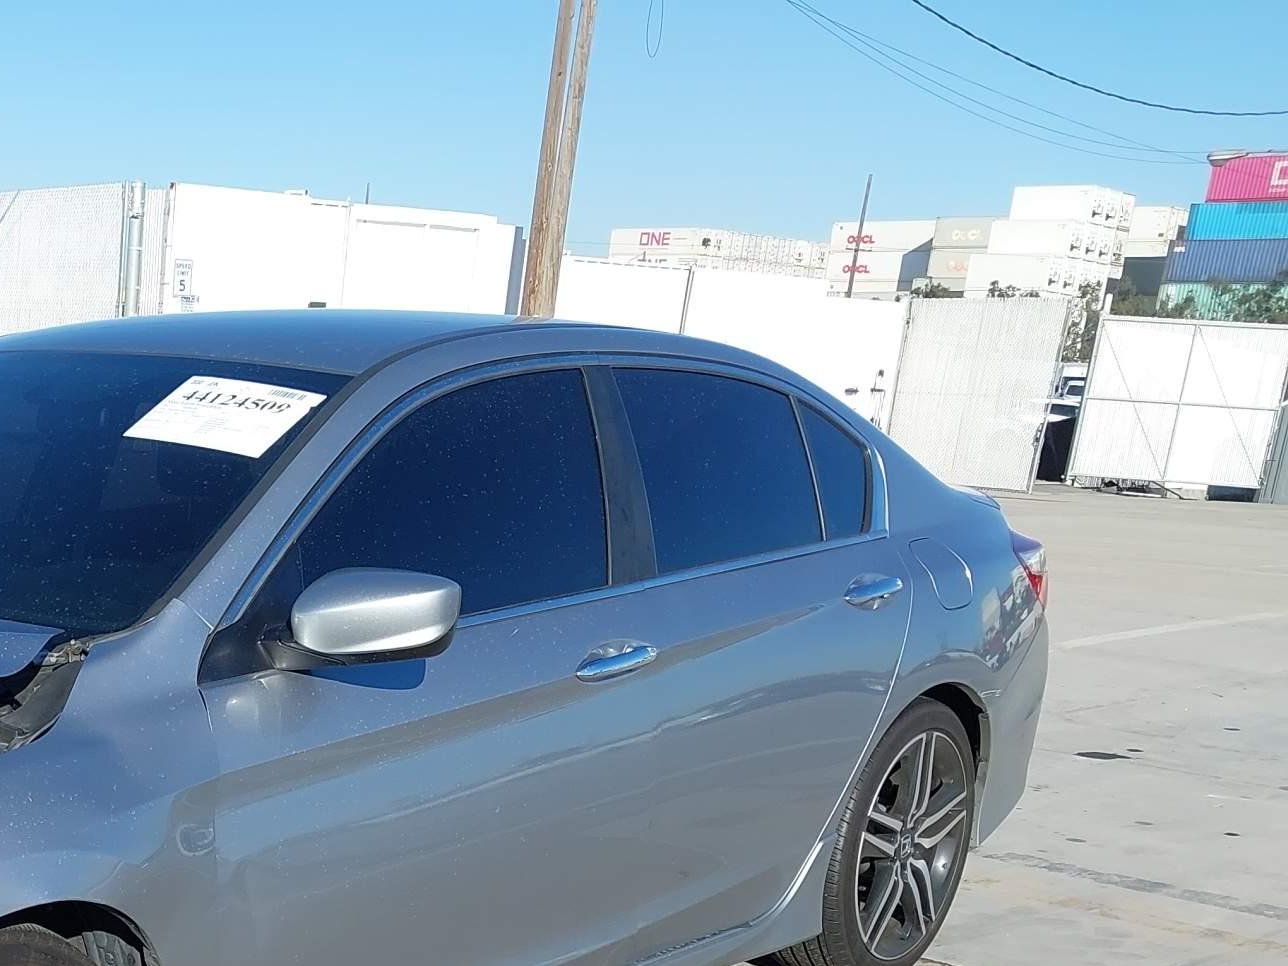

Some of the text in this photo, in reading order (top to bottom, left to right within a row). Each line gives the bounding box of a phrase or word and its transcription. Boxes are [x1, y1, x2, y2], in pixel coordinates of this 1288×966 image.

[639, 231, 671, 246] ONE
[179, 279, 186, 292] 5
[182, 390, 291, 414] 44124509
